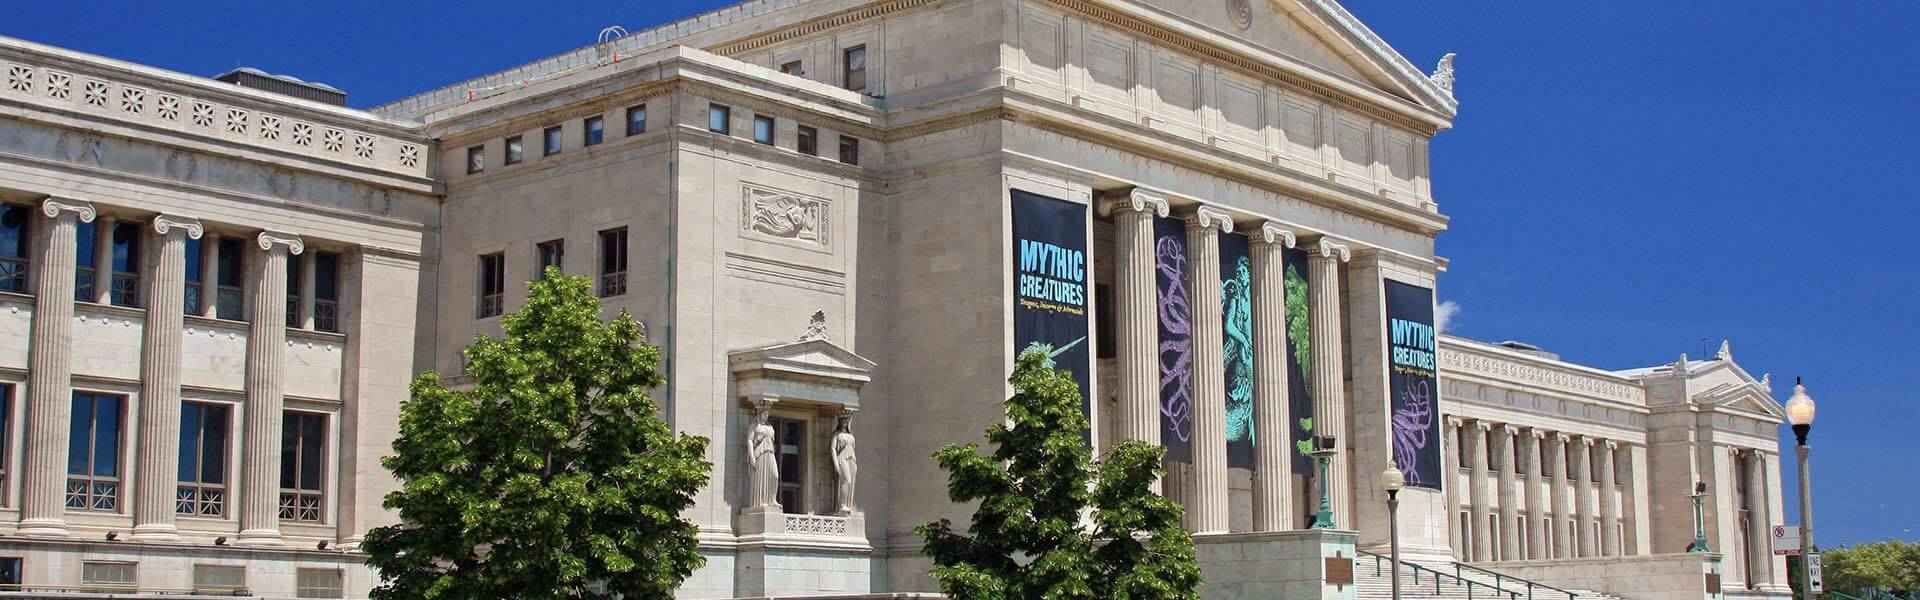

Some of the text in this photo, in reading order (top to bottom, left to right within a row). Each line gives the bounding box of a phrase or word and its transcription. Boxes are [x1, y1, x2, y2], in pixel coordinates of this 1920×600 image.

[1020, 239, 1083, 282] MYTHIC
[1020, 274, 1083, 306] CREATURES
[1391, 318, 1434, 351] MYTHIC
[1393, 346, 1434, 370] CREATURES
[1808, 556, 1819, 566] ONE
